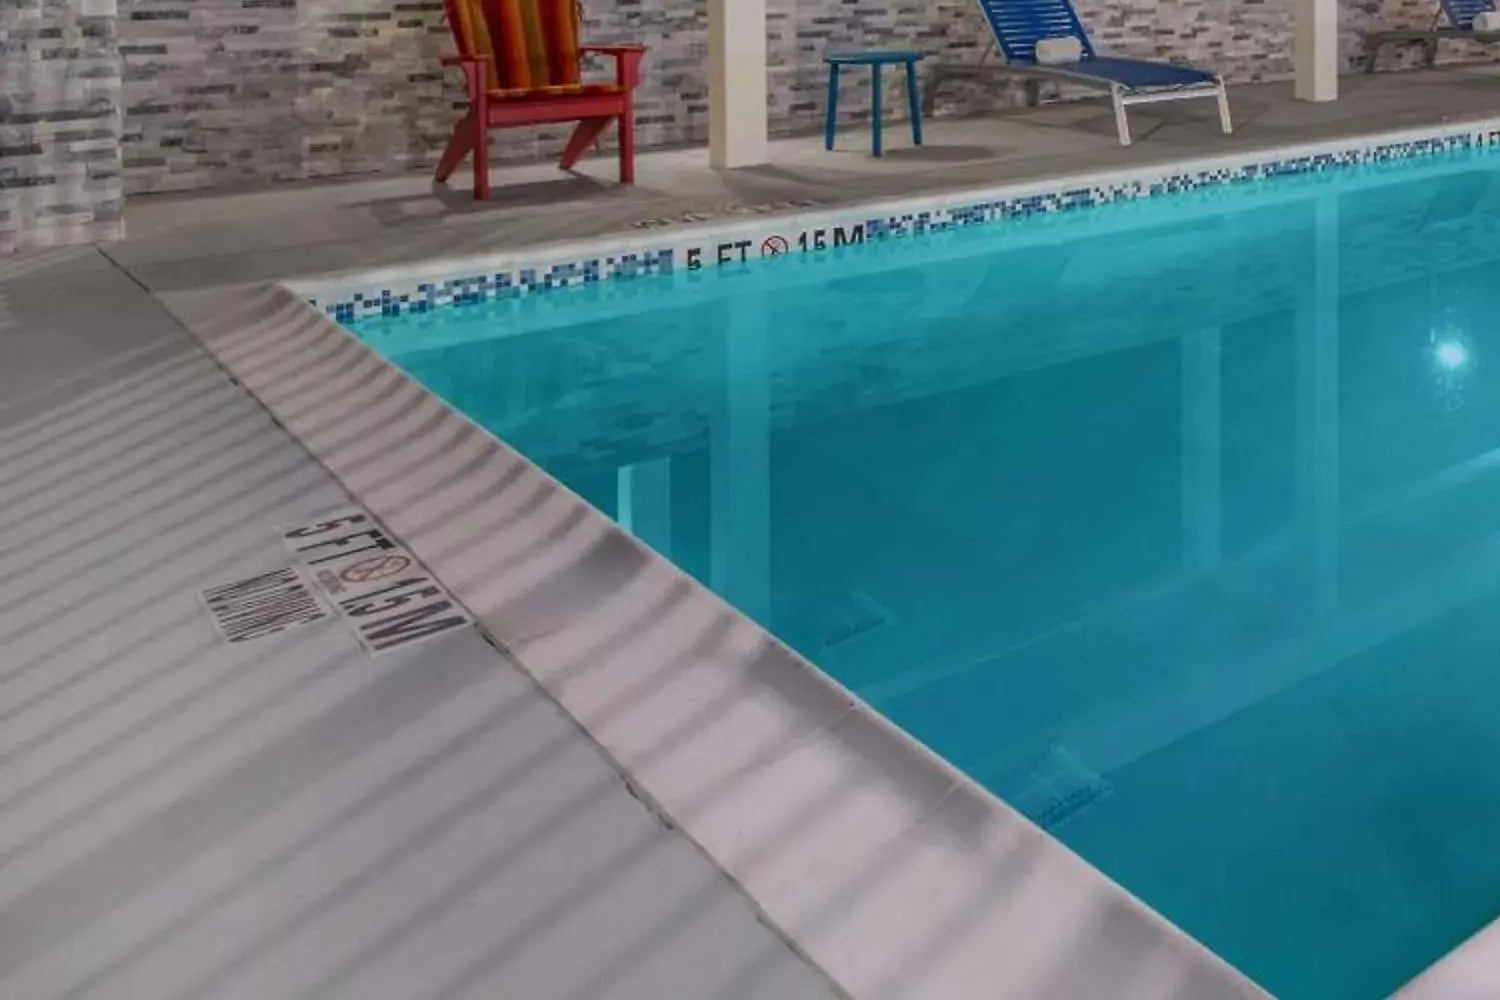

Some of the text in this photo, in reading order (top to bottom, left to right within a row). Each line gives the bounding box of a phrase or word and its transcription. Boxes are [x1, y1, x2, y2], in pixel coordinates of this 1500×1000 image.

[687, 247, 702, 271] 5
[717, 240, 752, 266] FT
[296, 527, 397, 566] FT
